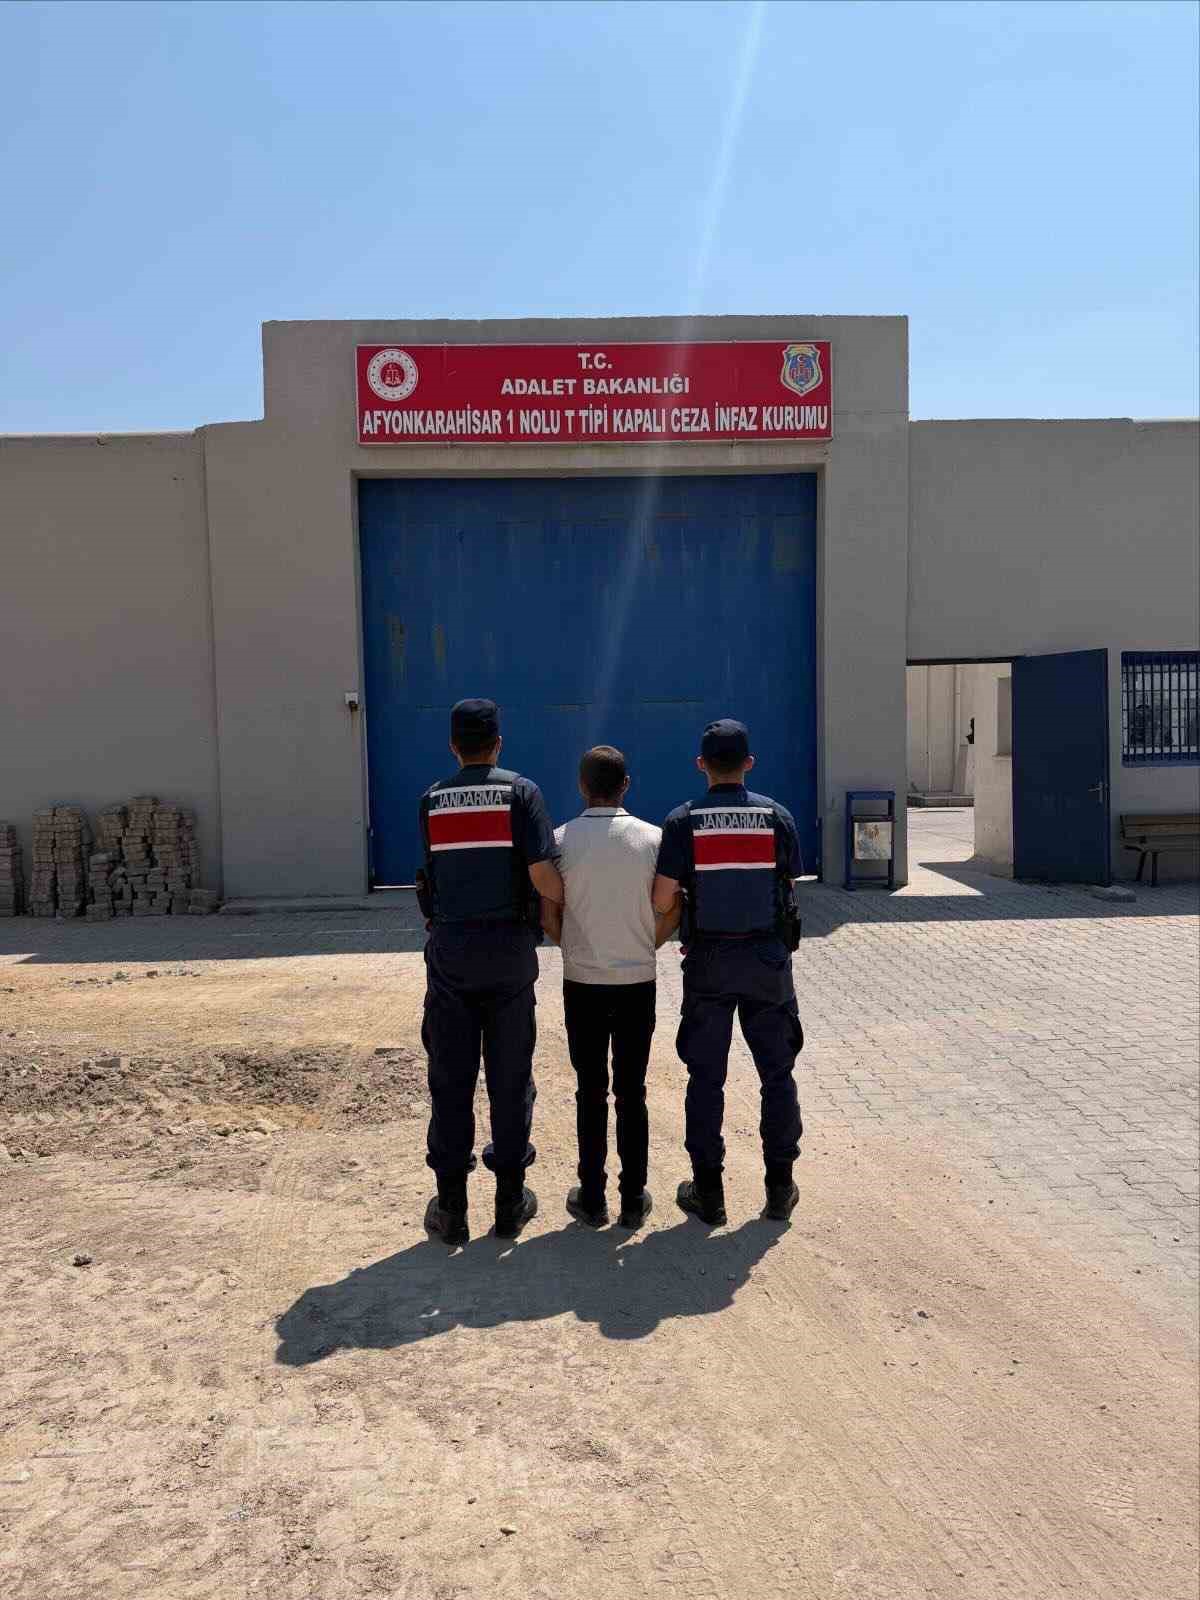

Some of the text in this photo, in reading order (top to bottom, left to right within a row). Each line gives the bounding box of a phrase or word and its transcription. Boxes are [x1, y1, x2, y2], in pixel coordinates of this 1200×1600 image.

[578, 352, 613, 370] T.C.
[501, 373, 690, 396] ADALET BAKANLIĞI
[362, 402, 828, 435] AFYONKARAHİSAR 1 NOLU T TİPİ KAPALI CEZA İNFAZ KURUMU
[435, 790, 504, 809] JANDARMA
[700, 813, 767, 830] JANDARMA
